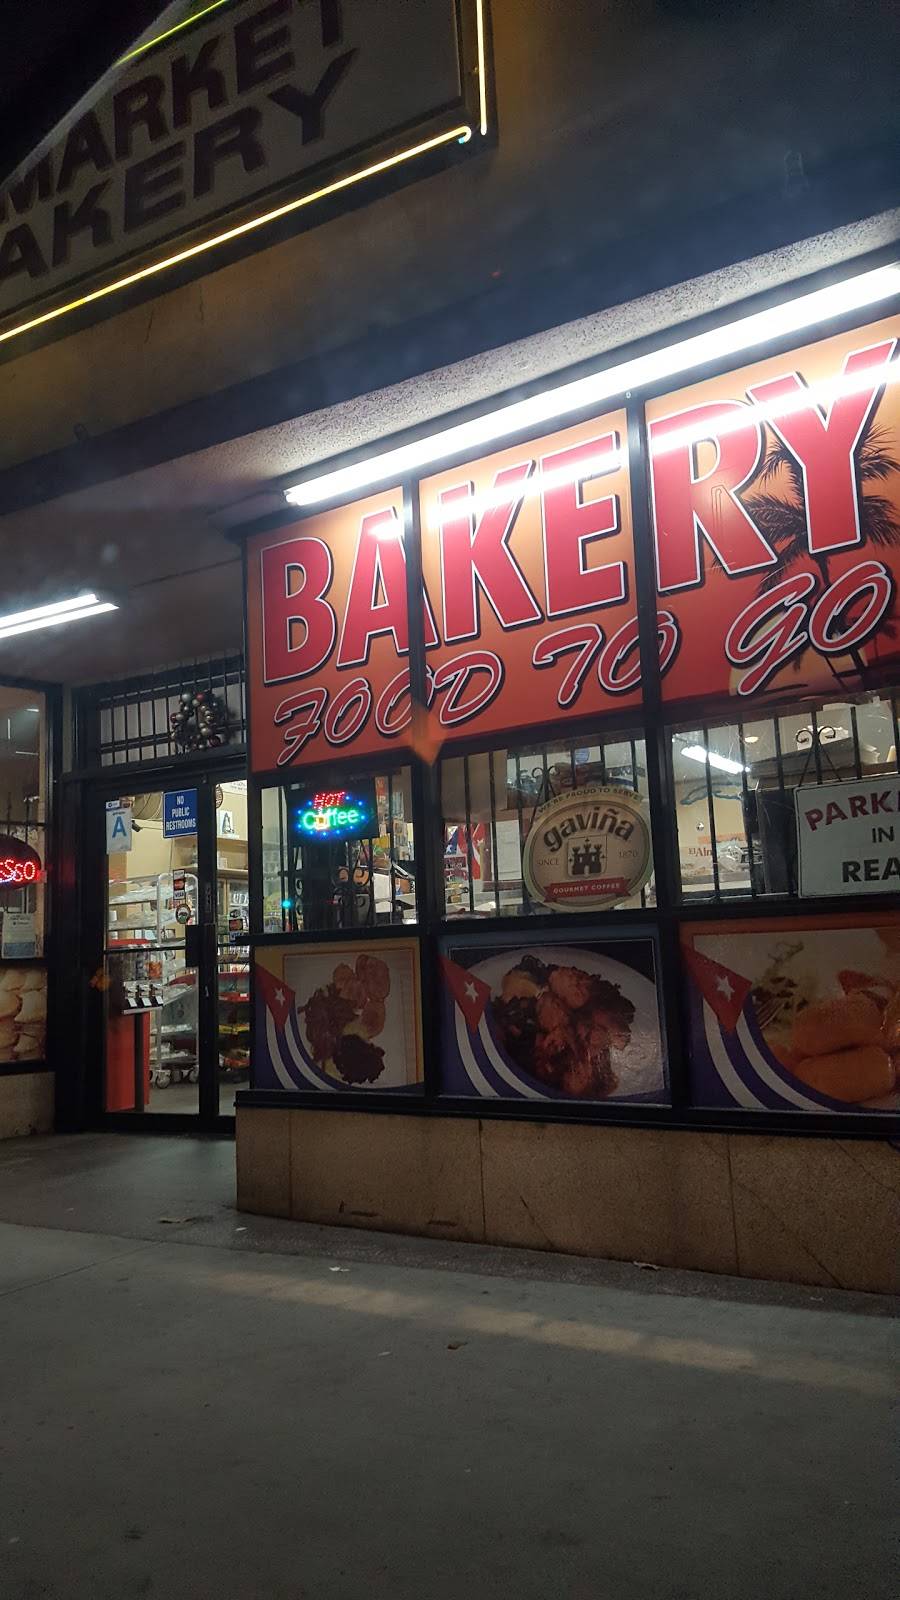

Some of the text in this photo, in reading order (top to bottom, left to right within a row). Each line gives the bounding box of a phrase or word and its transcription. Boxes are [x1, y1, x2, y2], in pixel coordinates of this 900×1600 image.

[260, 337, 898, 684] BAKERY
[274, 560, 893, 768] FOOD TO GO
[176, 795, 185, 806] NO
[313, 791, 346, 810] HOT
[566, 787, 597, 799] PROUD
[171, 807, 190, 818] PUBLIC
[302, 807, 360, 831] Coffee
[112, 815, 127, 838] A
[165, 818, 197, 831] RESTROOMS
[543, 806, 635, 853] gaviña
[872, 826, 895, 843] IN
[842, 857, 900, 883] REA
[553, 881, 621, 895] GOURMET COFFEE
